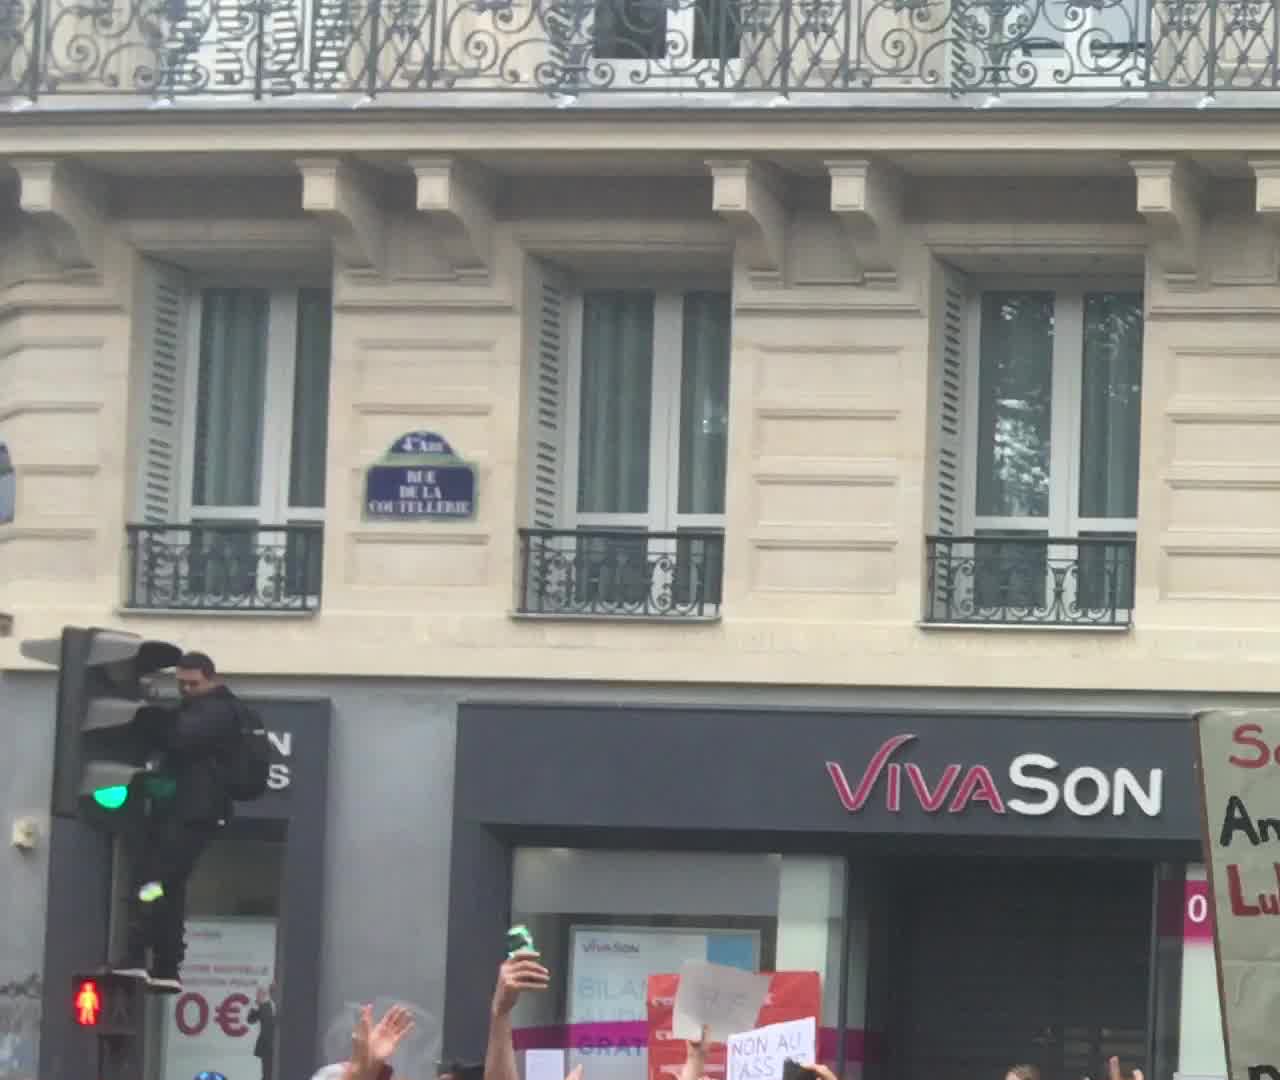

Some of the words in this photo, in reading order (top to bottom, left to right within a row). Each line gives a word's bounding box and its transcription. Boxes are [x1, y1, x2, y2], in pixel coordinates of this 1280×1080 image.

[407, 470, 437, 484] RUE
[578, 1031, 647, 1056] GRAT
[731, 1036, 768, 1057] NON
[776, 1031, 802, 1053] AU
[731, 1056, 775, 1080] PASS
